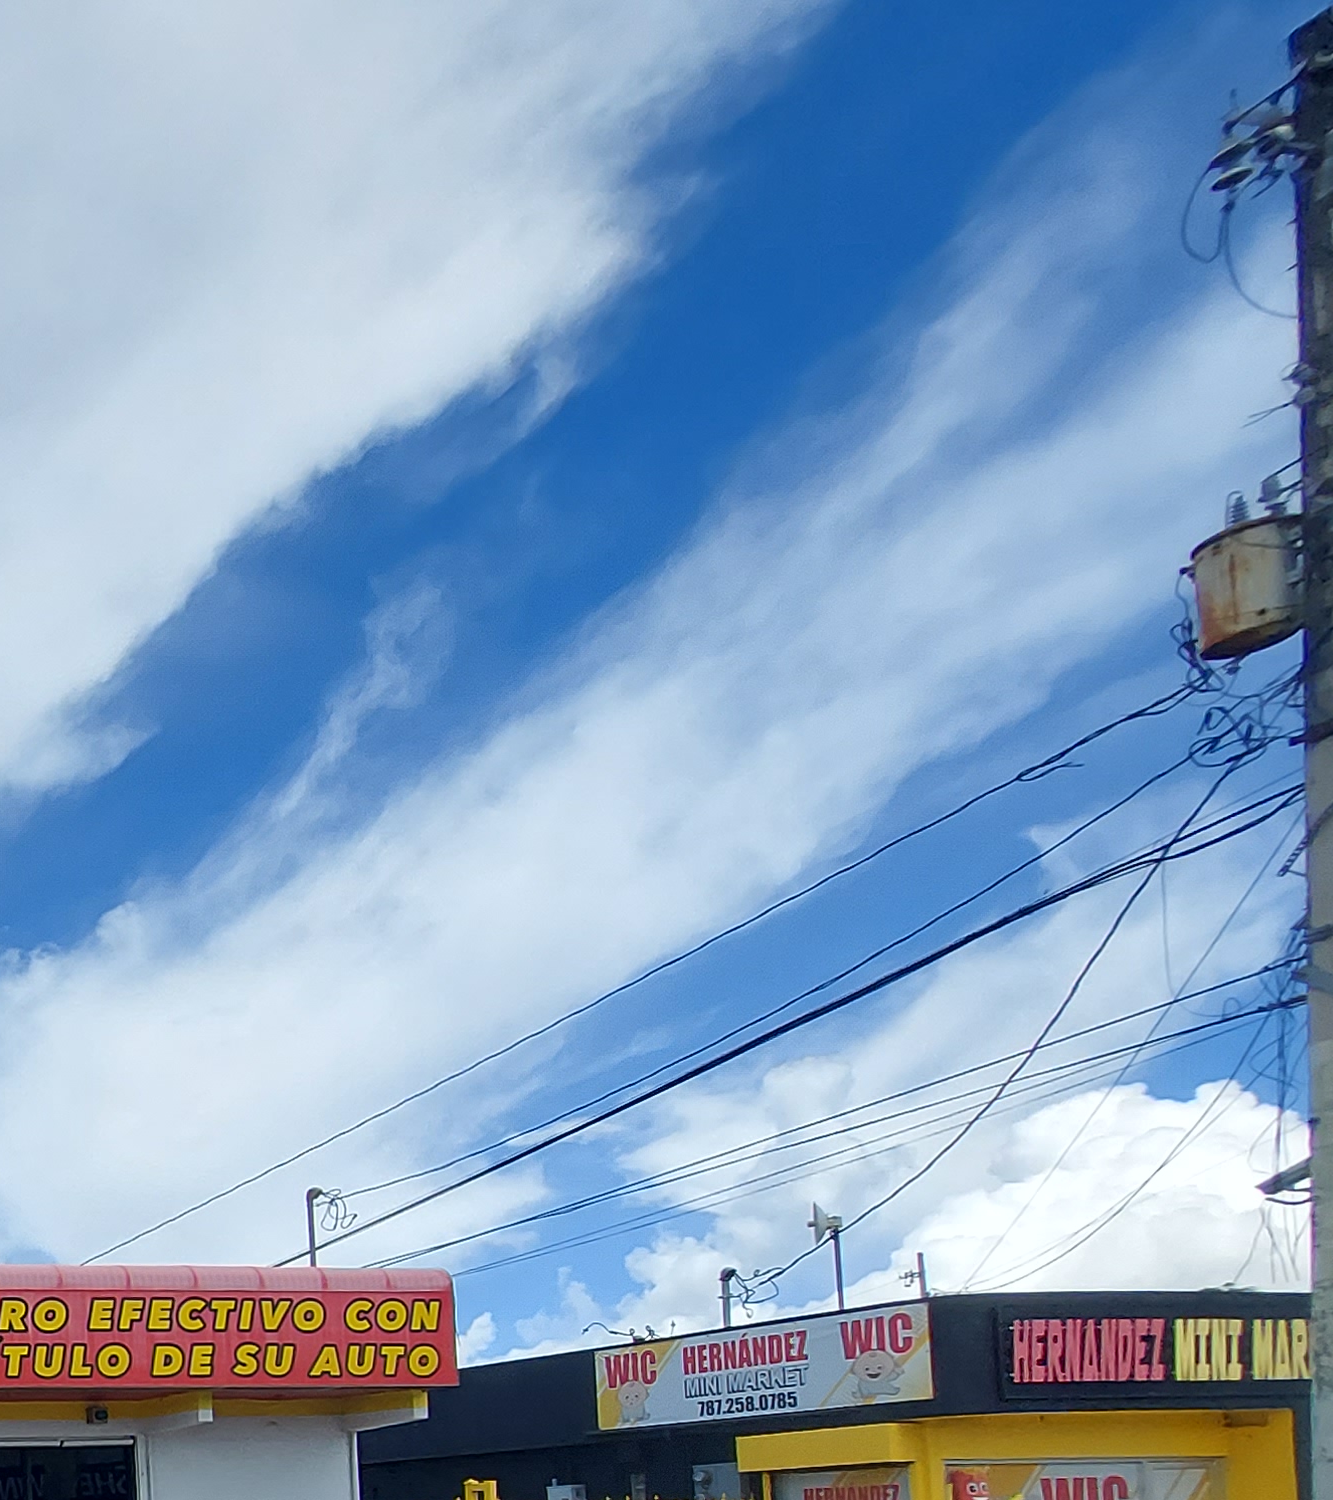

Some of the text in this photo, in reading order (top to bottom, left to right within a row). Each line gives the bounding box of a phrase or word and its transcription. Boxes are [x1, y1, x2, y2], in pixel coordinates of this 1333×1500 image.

[87, 1298, 327, 1334] EFECTIVO
[342, 1299, 444, 1333] CON
[682, 1329, 809, 1375] HERNÁNDEZ
[839, 1312, 915, 1361] WIC
[1013, 1317, 1312, 1383] HERNANDEZ MINI MAR
[150, 1343, 215, 1378] DE
[231, 1343, 297, 1379] SU
[308, 1343, 443, 1379] AUTO
[604, 1349, 658, 1390] WIC
[683, 1364, 810, 1399] MINI MARKET
[696, 1391, 799, 1418] 787.258.0785
